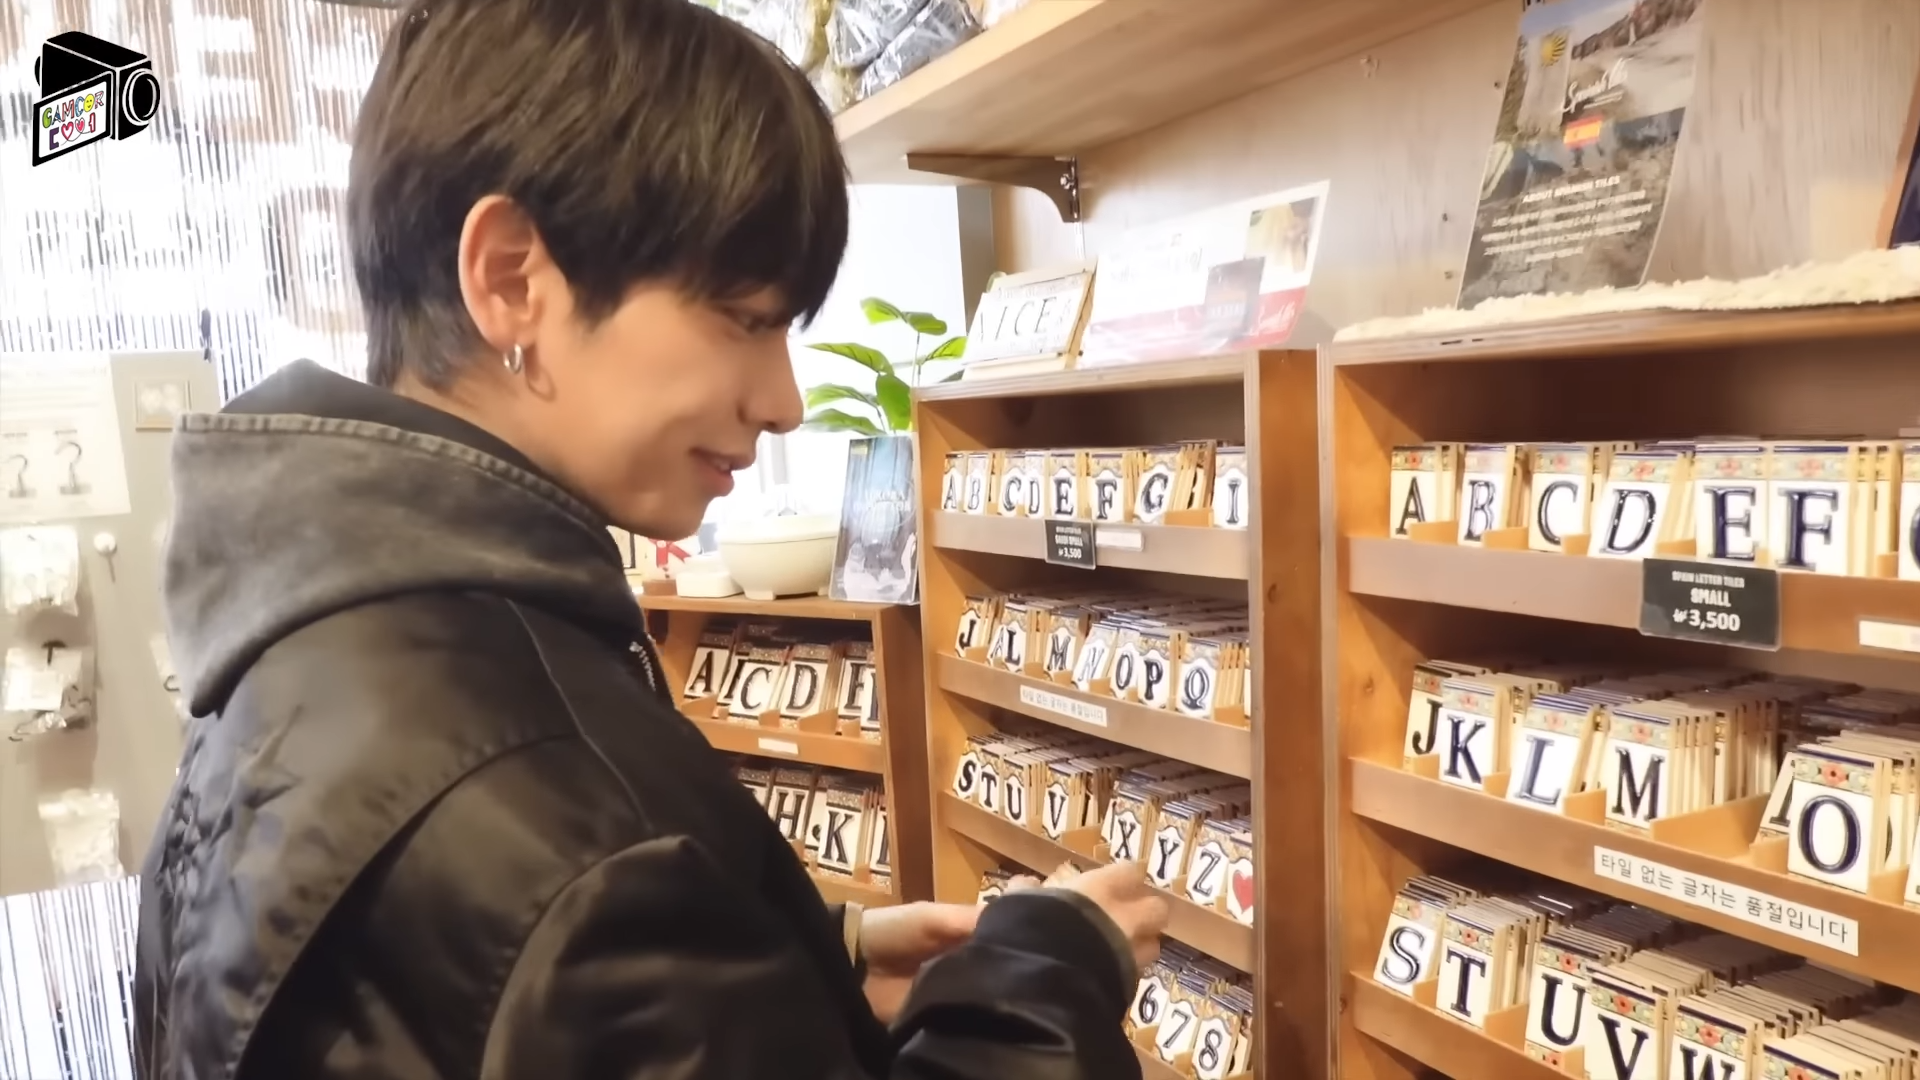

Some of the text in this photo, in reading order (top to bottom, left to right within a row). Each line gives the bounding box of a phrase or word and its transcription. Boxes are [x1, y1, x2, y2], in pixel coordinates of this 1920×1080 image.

[944, 474, 957, 509] A
[968, 475, 981, 510] B
[1003, 475, 1022, 512] C
[1028, 479, 1041, 514] D
[1054, 478, 1074, 516] E
[1096, 479, 1117, 519] F
[1139, 473, 1169, 514] G
[1227, 478, 1240, 525] I
[1396, 477, 1426, 535] A
[1464, 479, 1497, 541] B
[1537, 481, 1579, 545] C
[1599, 488, 1658, 554] D
[1702, 485, 1759, 562] E
[1775, 488, 1838, 571] F
[1690, 587, 1731, 607] SMALL
[958, 618, 977, 649] J
[1005, 628, 1021, 666] L
[1047, 633, 1071, 671] M
[689, 650, 714, 693] A
[1077, 647, 1105, 682] N
[1115, 652, 1134, 690] O
[1144, 659, 1164, 700] P
[740, 667, 772, 710] C
[786, 663, 818, 710] D
[1182, 667, 1210, 710] Q
[1412, 698, 1443, 755] J
[1444, 714, 1486, 784] K
[1513, 734, 1562, 807] L
[958, 760, 977, 792] S
[981, 771, 997, 808] T
[1610, 746, 1666, 822] M
[1006, 783, 1022, 820] U
[1047, 790, 1066, 830] V
[822, 810, 853, 864] K
[1114, 817, 1136, 860] X
[1798, 794, 1862, 875] O
[1158, 837, 1180, 880] Y
[1193, 851, 1220, 897] Z
[1601, 854, 1848, 943] 타일 없는 글자는 품절입니다
[1380, 925, 1425, 985] S
[1445, 945, 1487, 1018] T
[1138, 984, 1159, 1024] 6
[1538, 973, 1588, 1047] U
[1162, 1008, 1192, 1049] 7
[1199, 1028, 1223, 1071] 8
[1596, 1013, 1652, 1080] V
